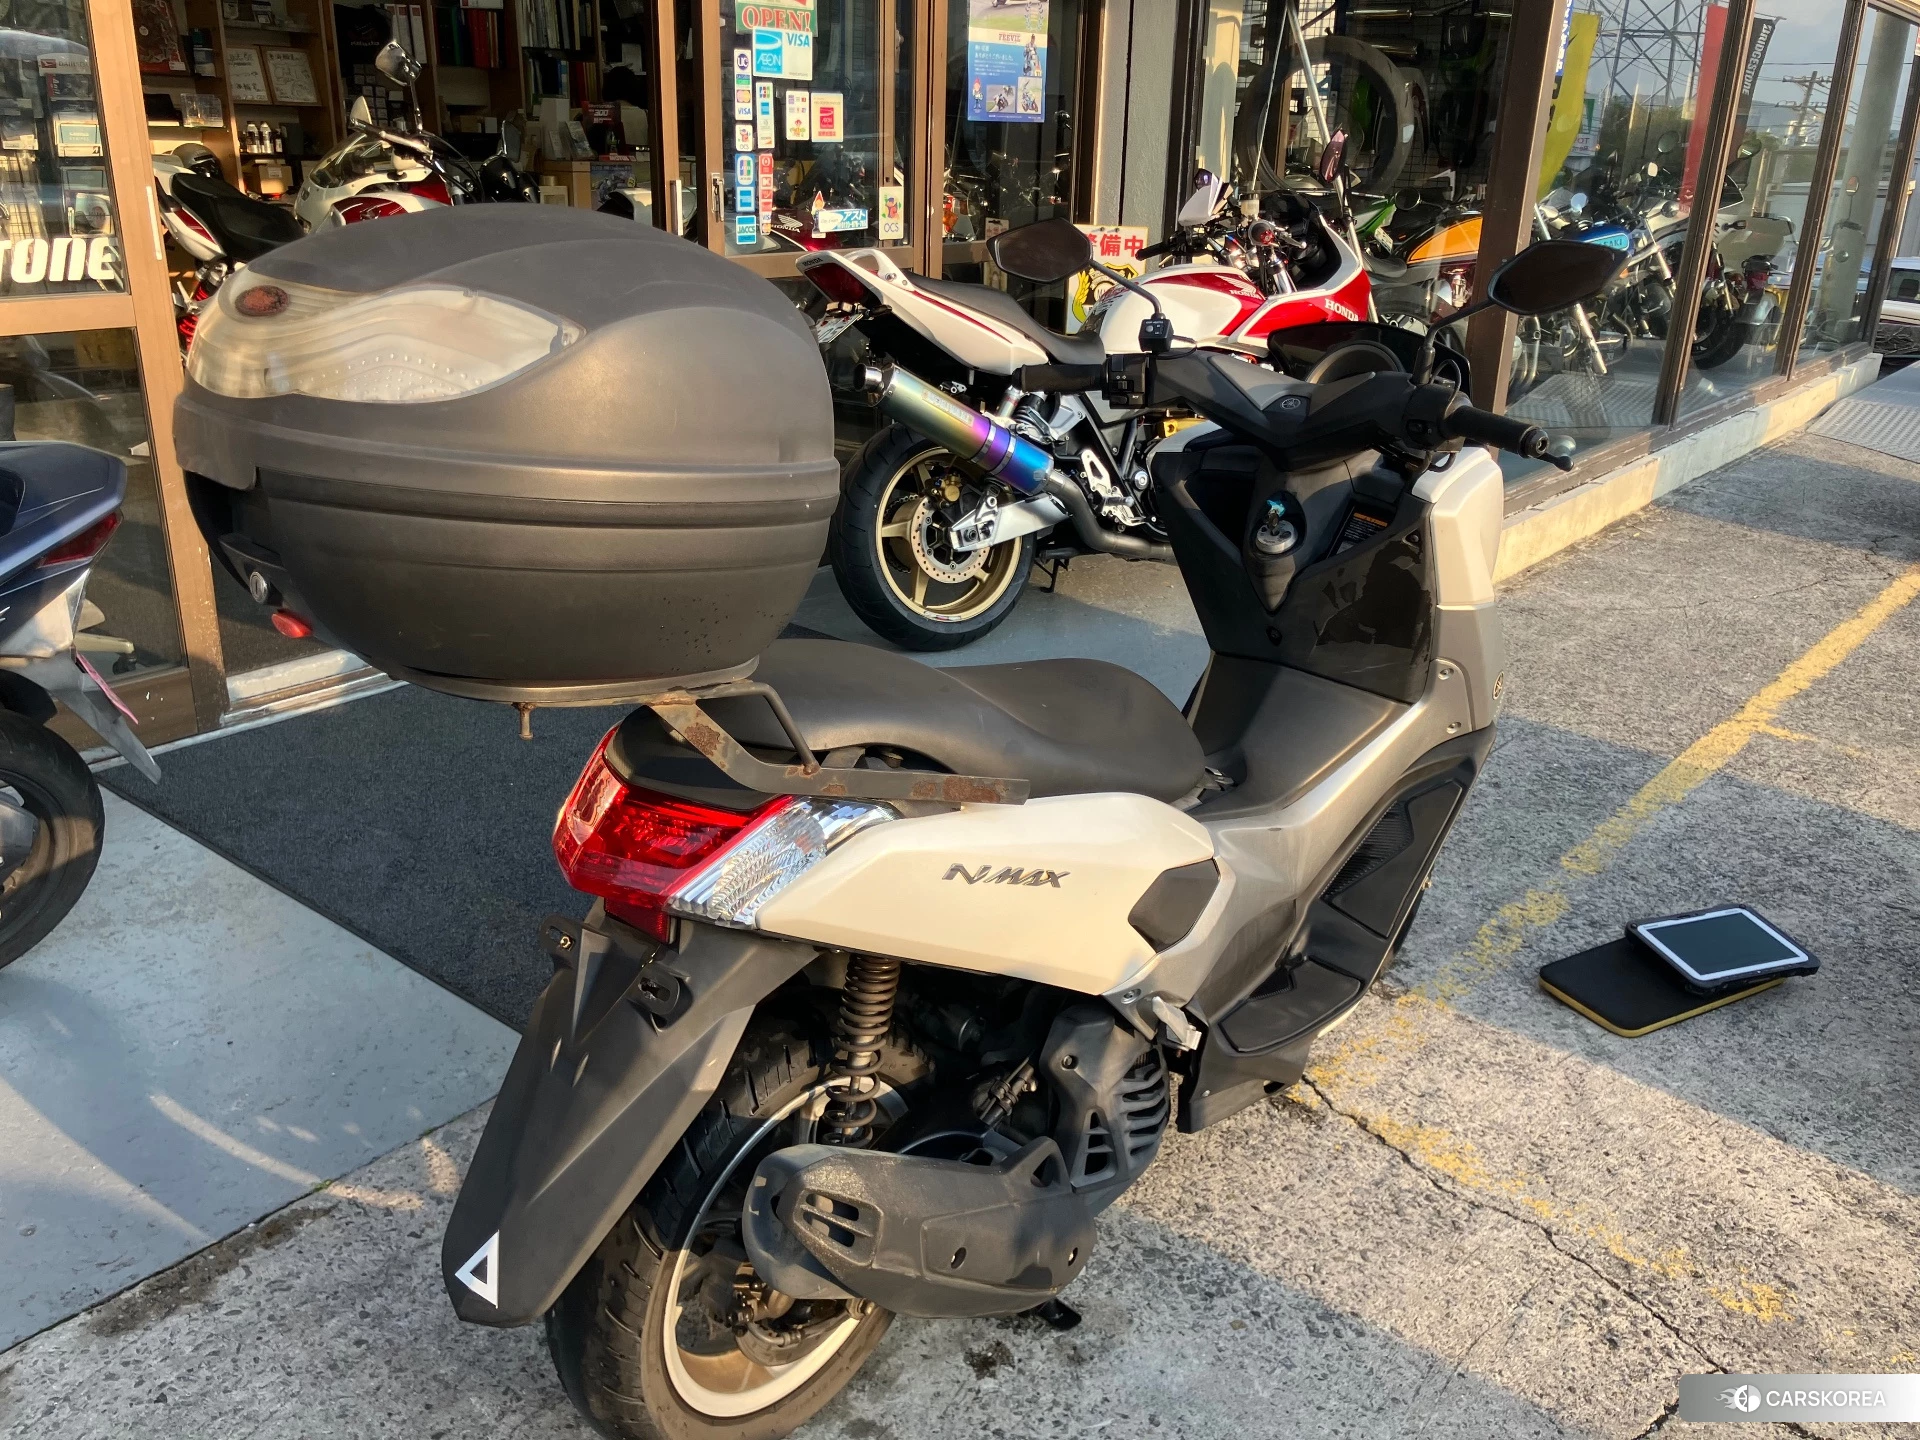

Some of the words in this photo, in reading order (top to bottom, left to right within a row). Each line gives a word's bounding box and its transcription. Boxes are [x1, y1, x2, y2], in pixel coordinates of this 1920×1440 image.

[742, 5, 811, 33] OPEN!
[786, 32, 810, 47] VISA
[737, 57, 749, 67] UC
[738, 107, 751, 115] VISA
[842, 209, 866, 221] アスト
[737, 225, 756, 234] JACCS
[884, 222, 899, 233] OCS
[1229, 289, 1262, 301] HONDA
[1324, 298, 1360, 322] HONDA
[942, 862, 1071, 888] NMAX
